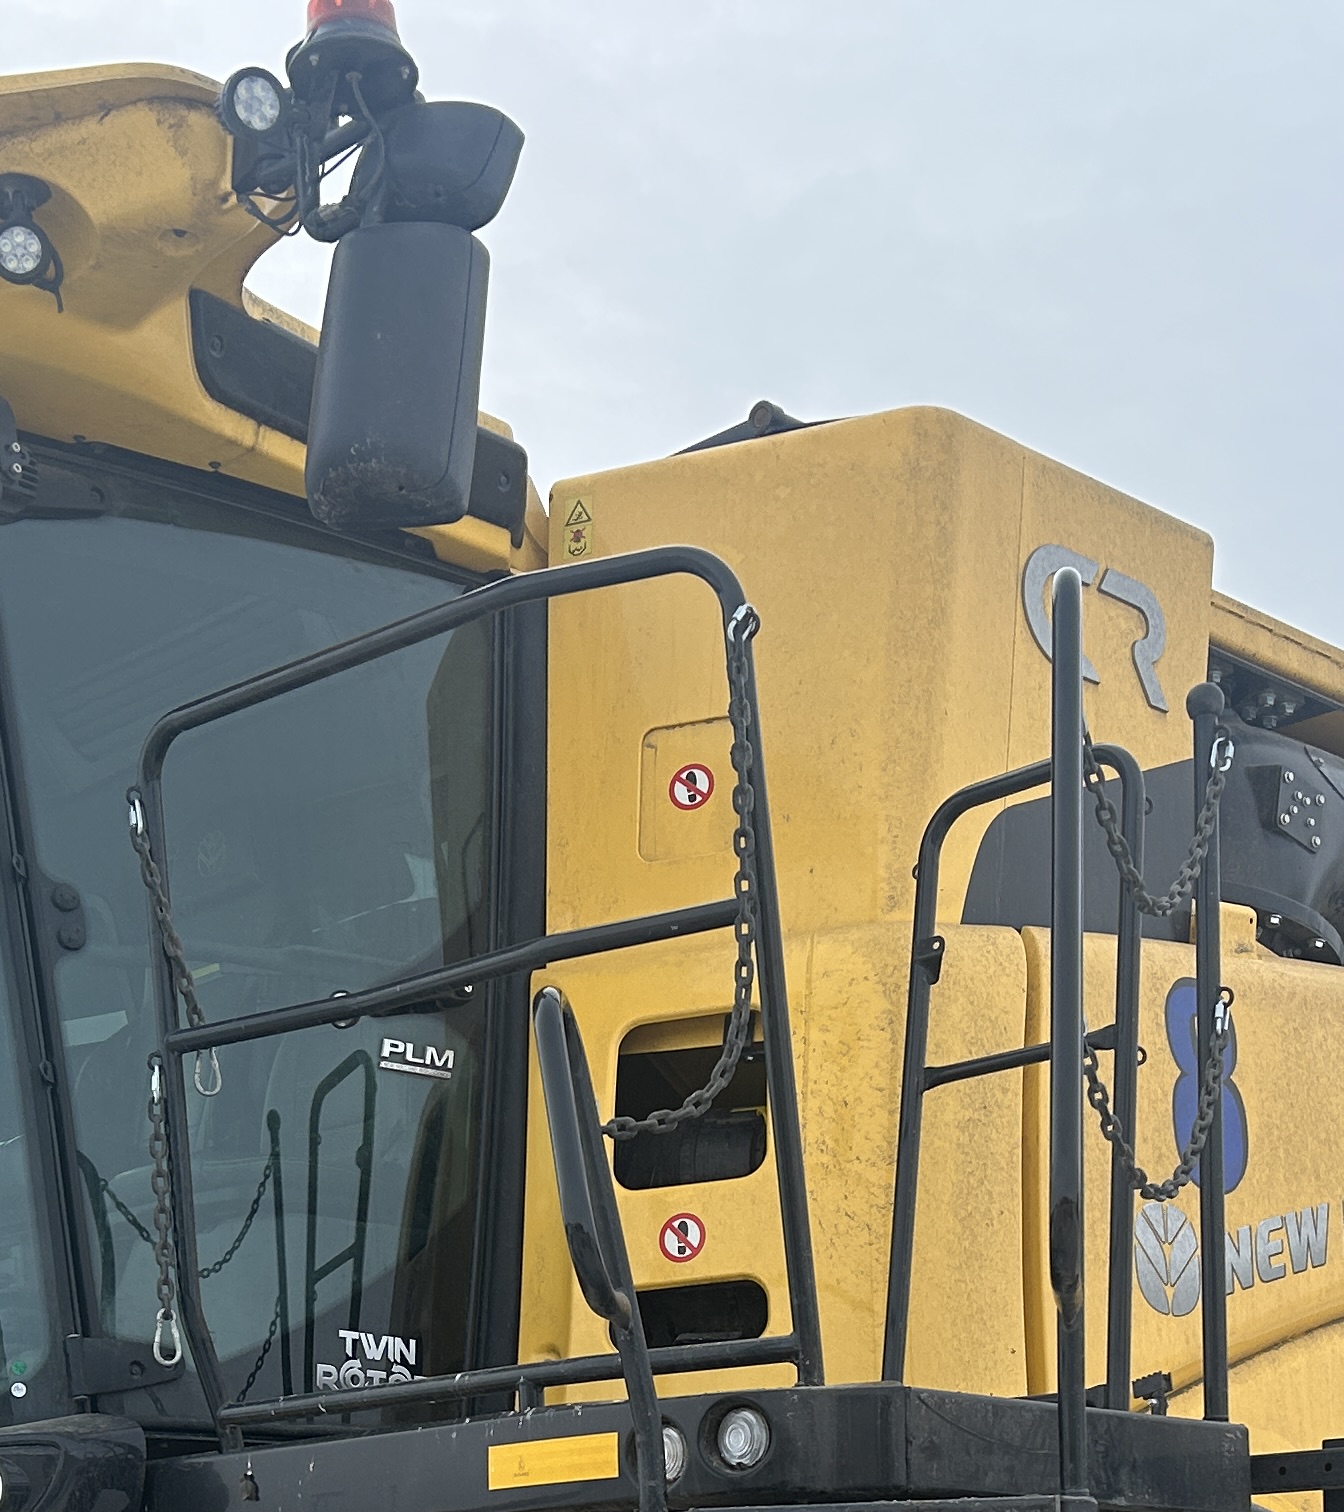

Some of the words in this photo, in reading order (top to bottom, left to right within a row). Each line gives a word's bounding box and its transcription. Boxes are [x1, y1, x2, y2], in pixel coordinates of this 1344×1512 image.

[1021, 543, 1169, 713] CR
[380, 1037, 455, 1069] PLM
[1224, 1202, 1330, 1295] NEW
[338, 1329, 417, 1365] TWIN
